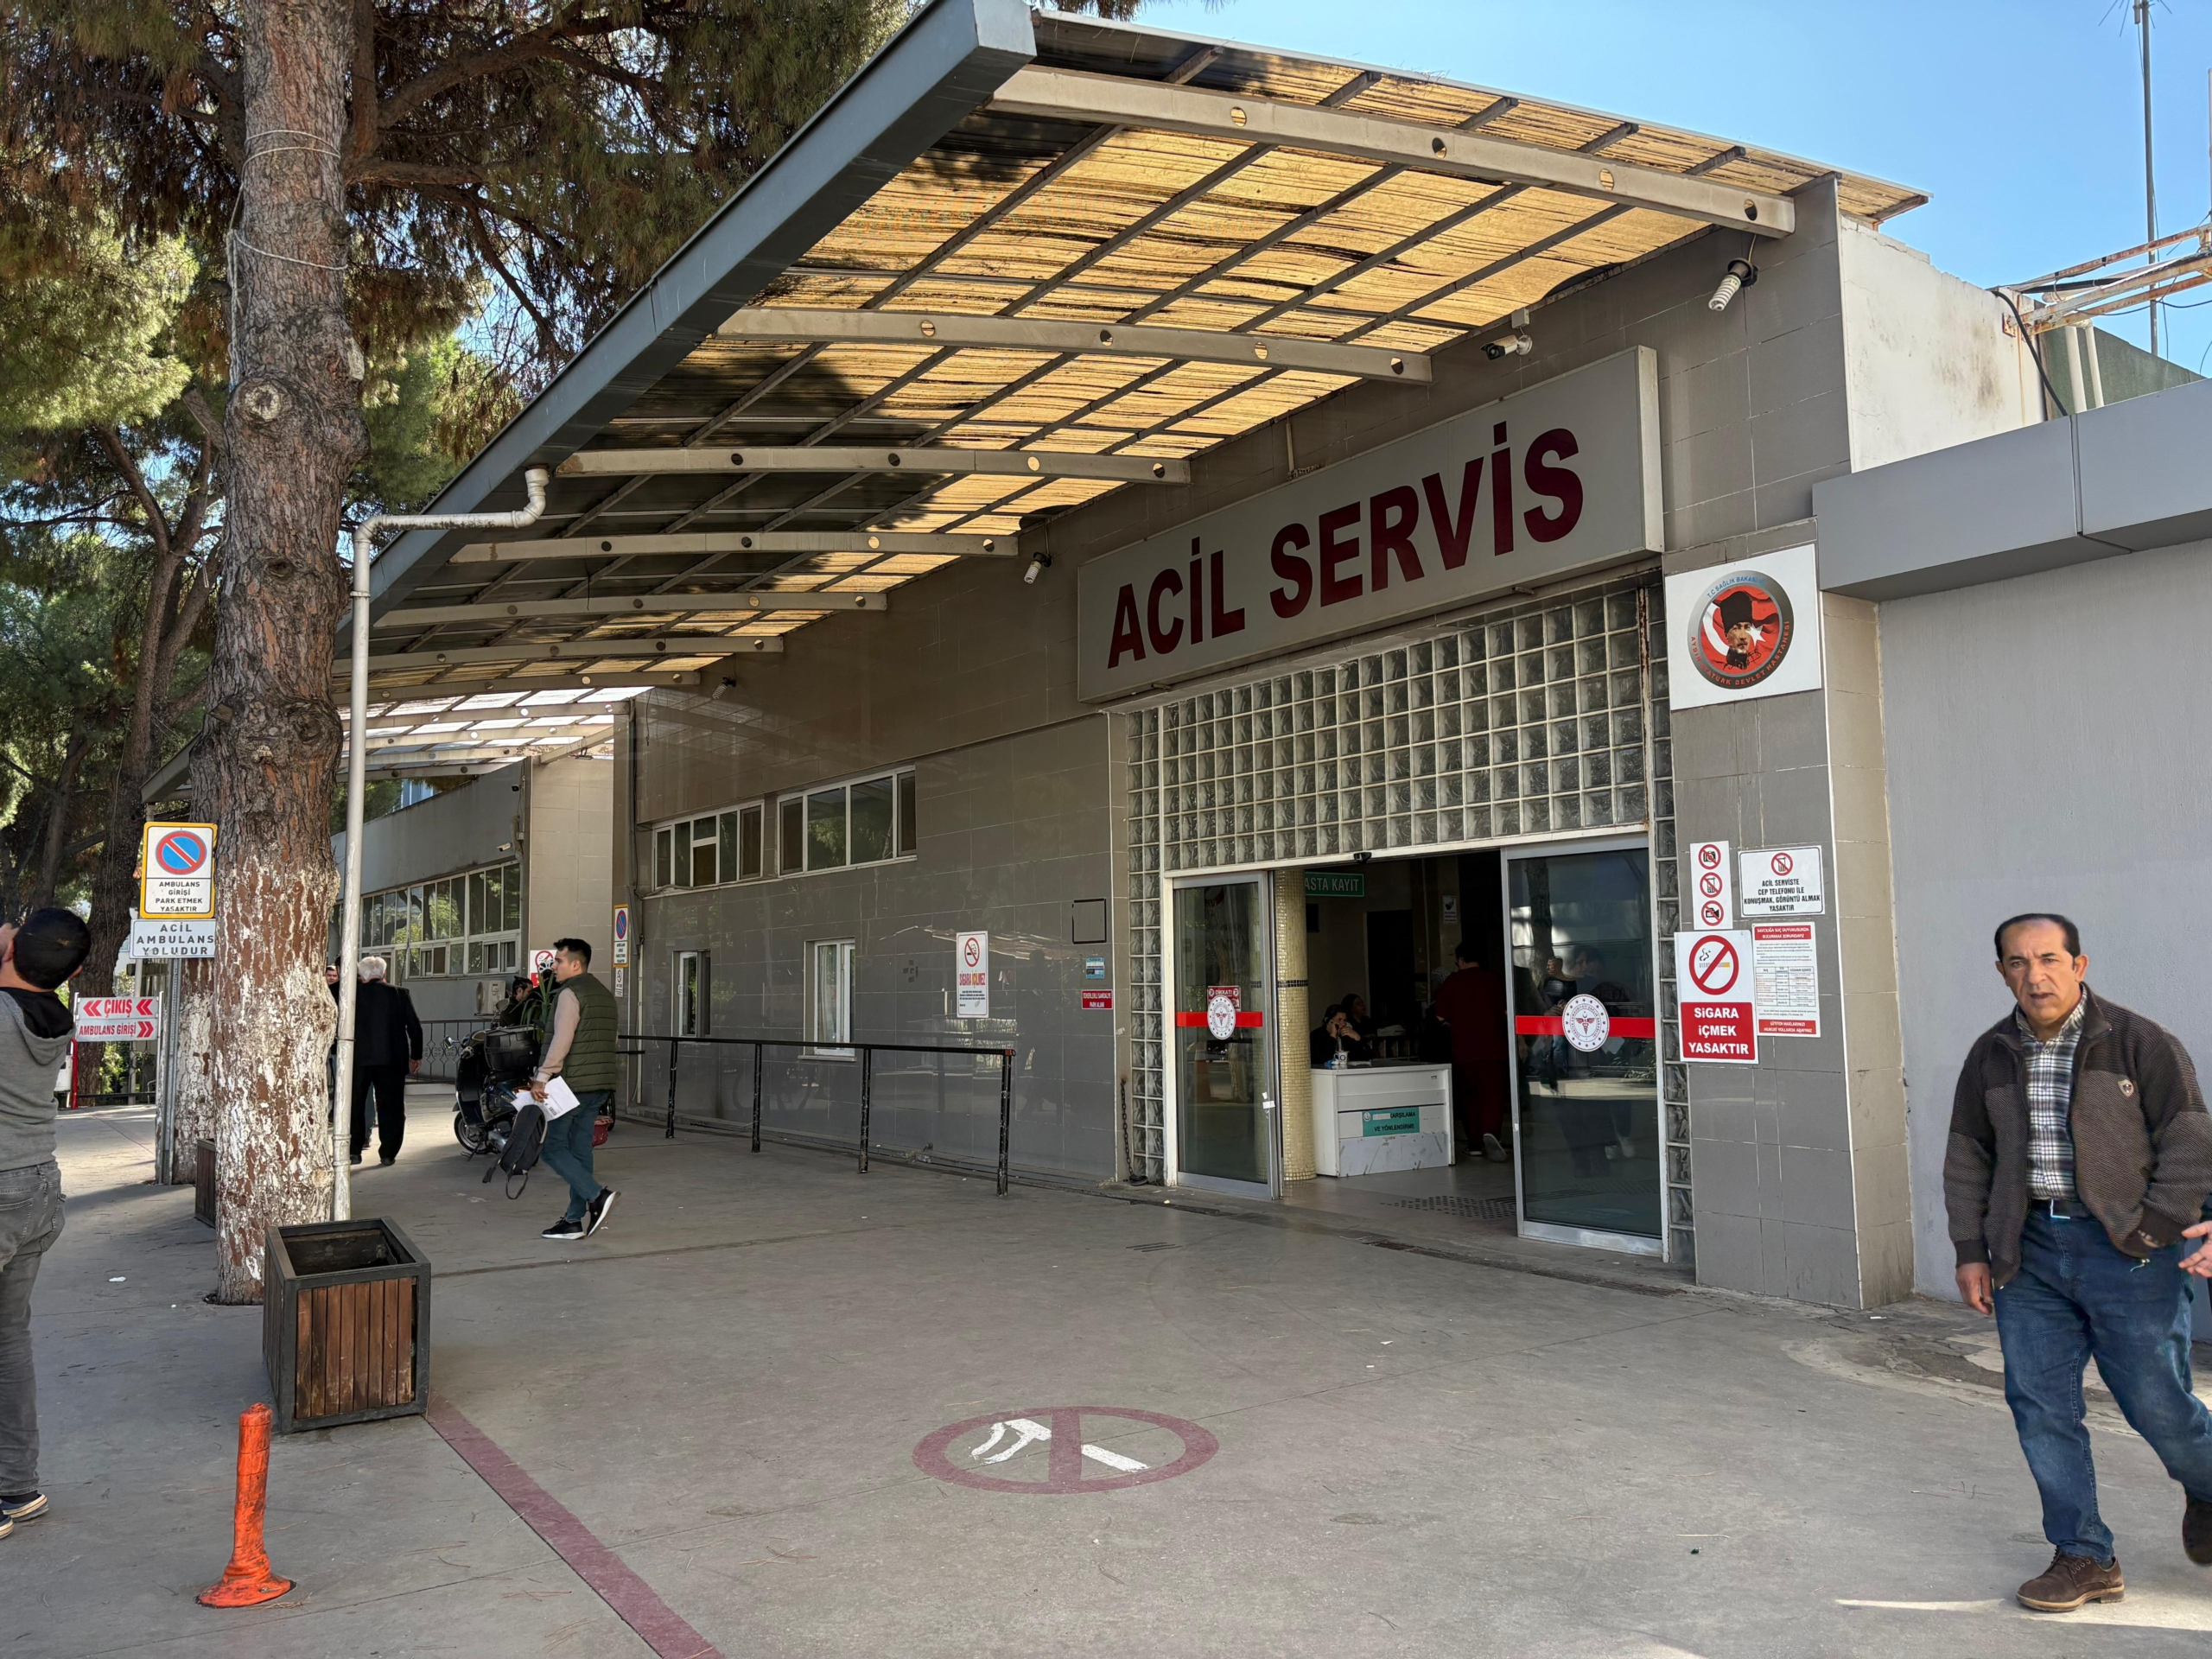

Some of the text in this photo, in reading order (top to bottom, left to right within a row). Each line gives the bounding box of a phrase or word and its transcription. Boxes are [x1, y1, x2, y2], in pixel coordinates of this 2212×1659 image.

[1107, 420, 1584, 670] ACİL SERVİS
[1715, 577, 1736, 592] SAĞLIK
[1305, 876, 1359, 892] ASTA KAYIT
[1775, 878, 1800, 887] SERVİSTE
[1776, 895, 1800, 904] GÖRÜNTÜ
[1769, 904, 1795, 912] YASAKTIR
[160, 921, 192, 932] ACİL
[136, 935, 214, 944] AMBULANS
[143, 946, 208, 956] YOLUDUR
[104, 999, 132, 1018] ÇIKIŞ
[79, 1022, 137, 1037] AMBULANS GİRİŞİ
[1688, 1042, 1749, 1054] YASAKTIR
[1382, 1123, 1415, 1132] YÖNLENDİRME
